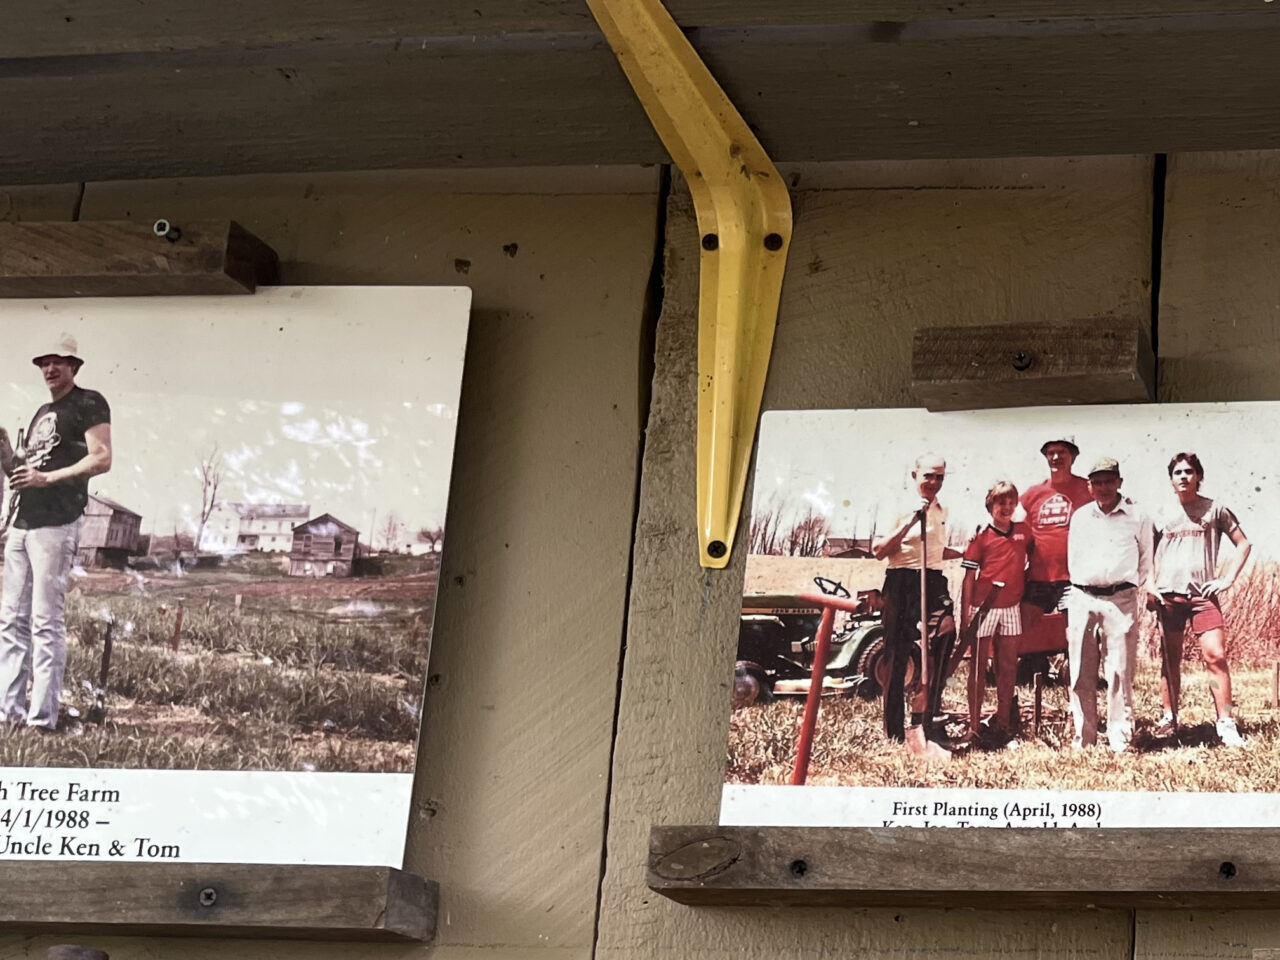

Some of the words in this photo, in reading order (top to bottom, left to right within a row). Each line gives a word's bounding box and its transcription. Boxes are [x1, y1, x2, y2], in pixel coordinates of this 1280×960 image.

[16, 781, 60, 801] Tree
[65, 782, 120, 802] Farm
[892, 801, 928, 816] First
[932, 801, 998, 820] Planting
[1003, 802, 1055, 820] (April,
[1061, 803, 1102, 821] 1988)
[0, 834, 52, 855] Uncle
[58, 836, 100, 856] Ken
[108, 839, 126, 857] &
[133, 837, 181, 858] Tom
